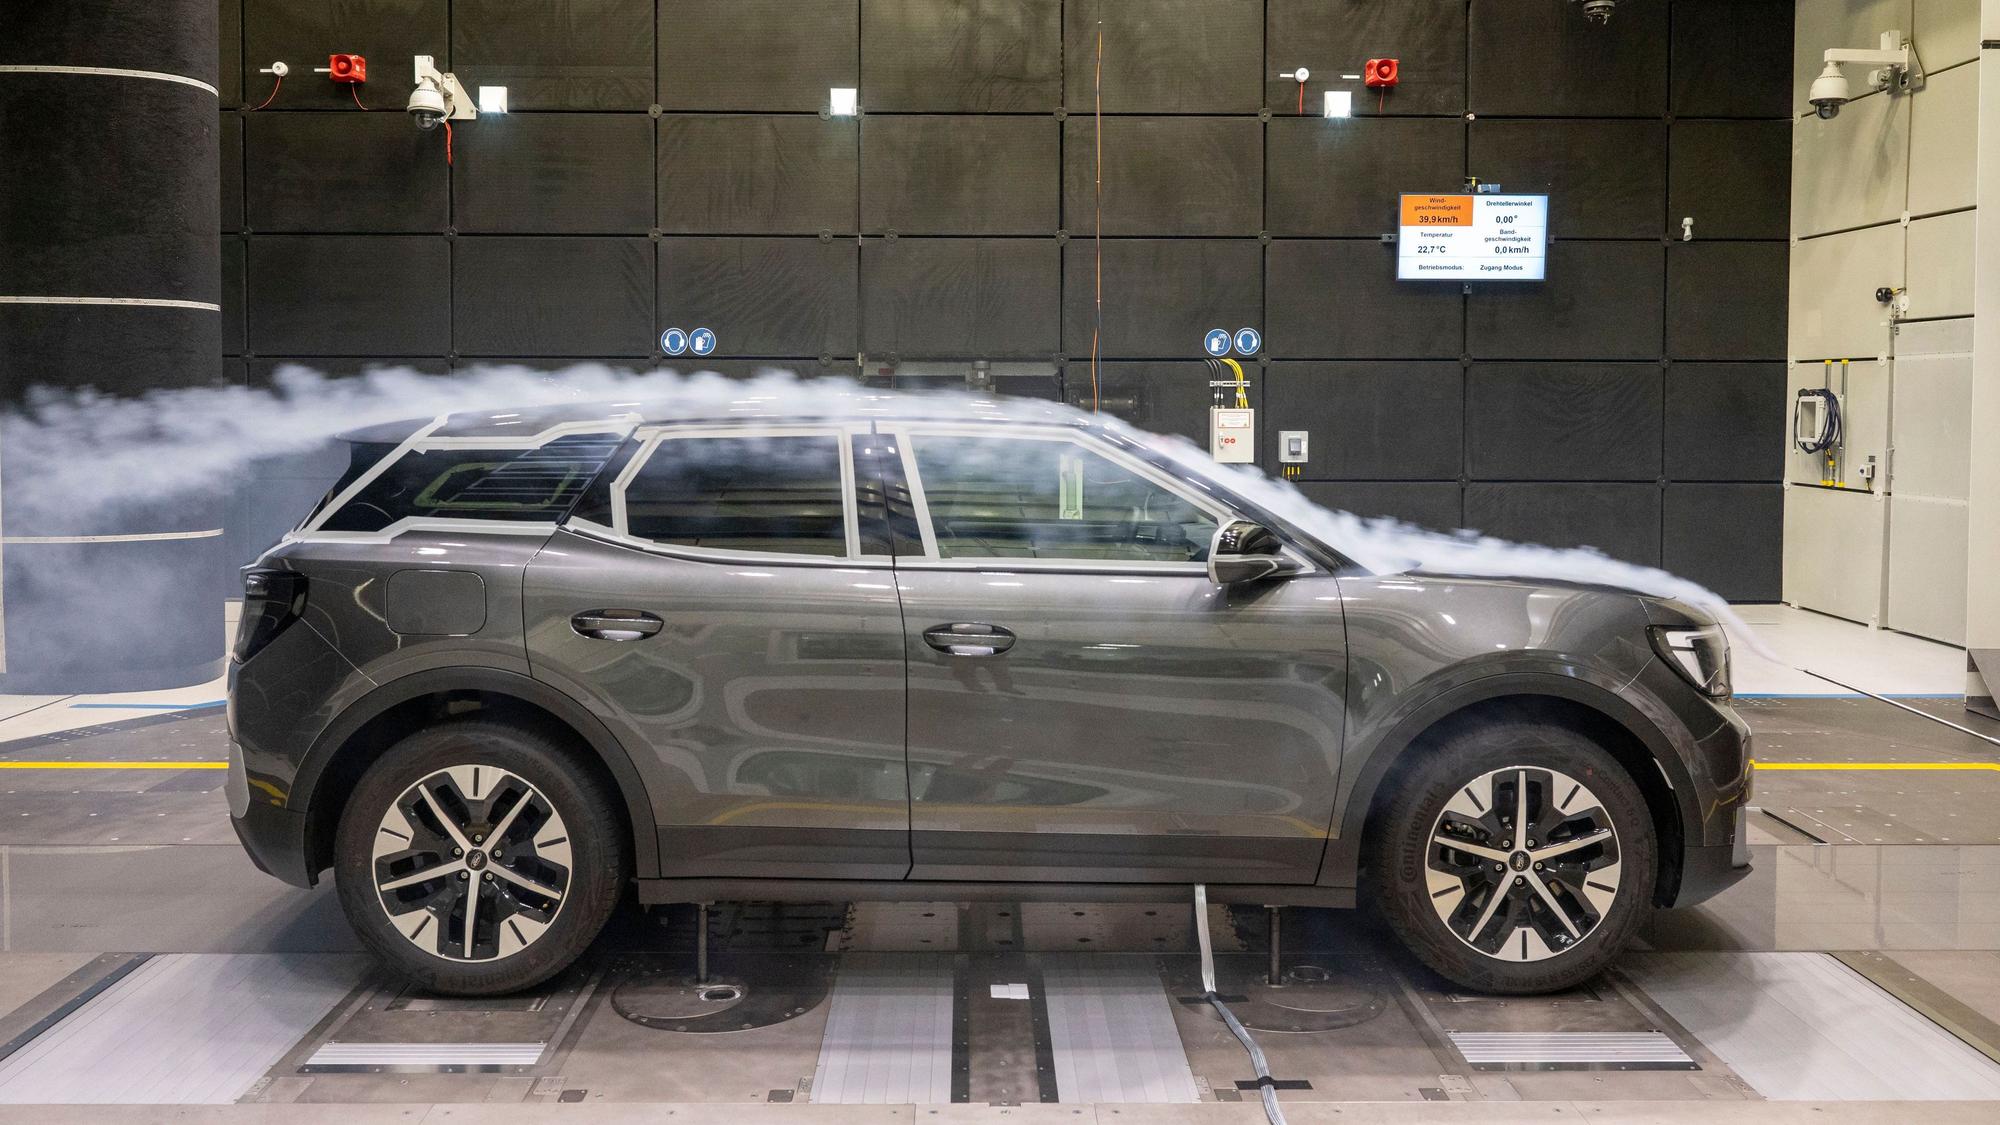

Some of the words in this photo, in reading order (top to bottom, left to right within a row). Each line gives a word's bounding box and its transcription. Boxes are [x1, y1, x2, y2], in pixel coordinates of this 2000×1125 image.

[1419, 215, 1437, 224] 39,9
[1437, 215, 1458, 223] km/h
[1417, 245, 1435, 254] 22,7
[1494, 246, 1508, 254] 0,0
[1508, 245, 1530, 254] km/h
[1480, 264, 1502, 272] Zugang
